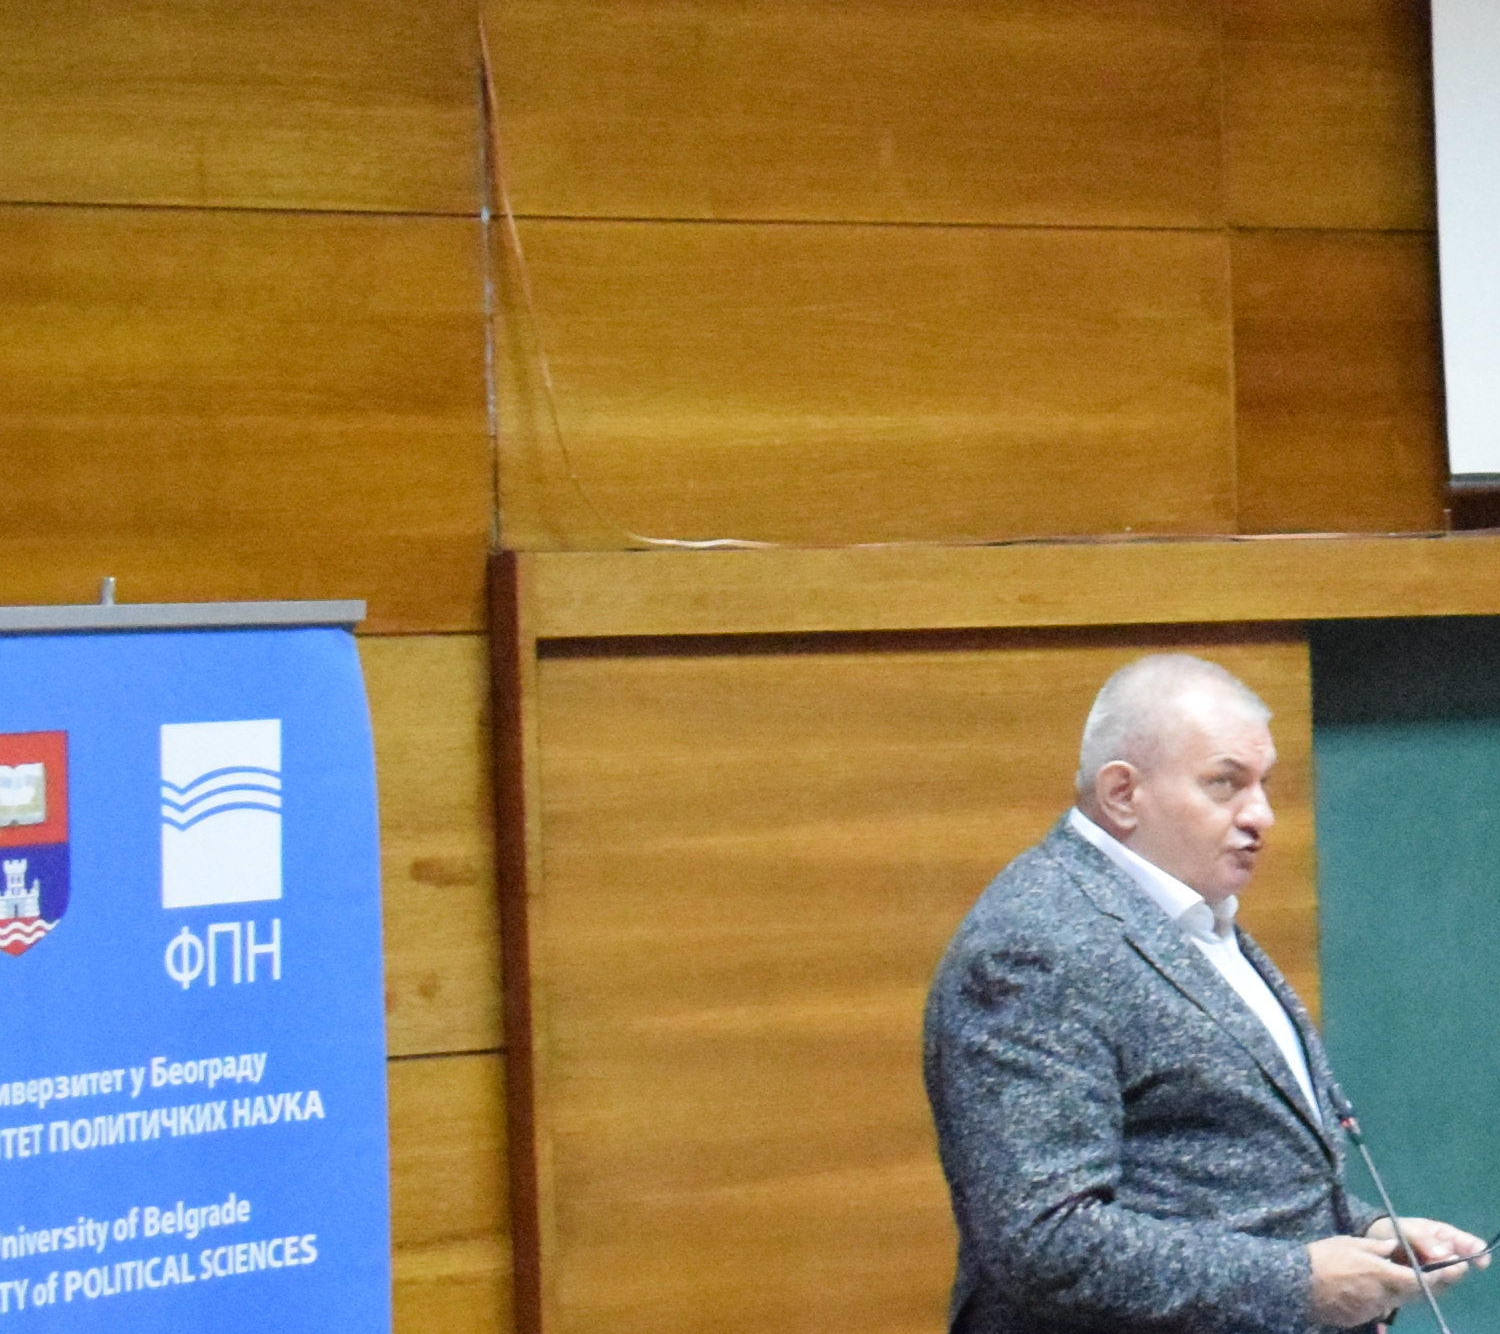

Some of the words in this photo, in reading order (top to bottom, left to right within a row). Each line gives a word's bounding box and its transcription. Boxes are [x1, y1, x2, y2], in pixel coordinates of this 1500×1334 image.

[165, 918, 282, 989] ФПН
[130, 1067, 146, 1098] у
[151, 1052, 268, 1088] Београду
[49, 1100, 227, 1153] ПОЛИТИЧКИХ
[232, 1090, 326, 1128] НАУКА
[113, 1206, 140, 1241] of
[144, 1192, 251, 1240] Belgrade
[33, 1271, 58, 1308] of
[64, 1252, 196, 1302] POLITICAL
[200, 1233, 318, 1280] SCIENCES
